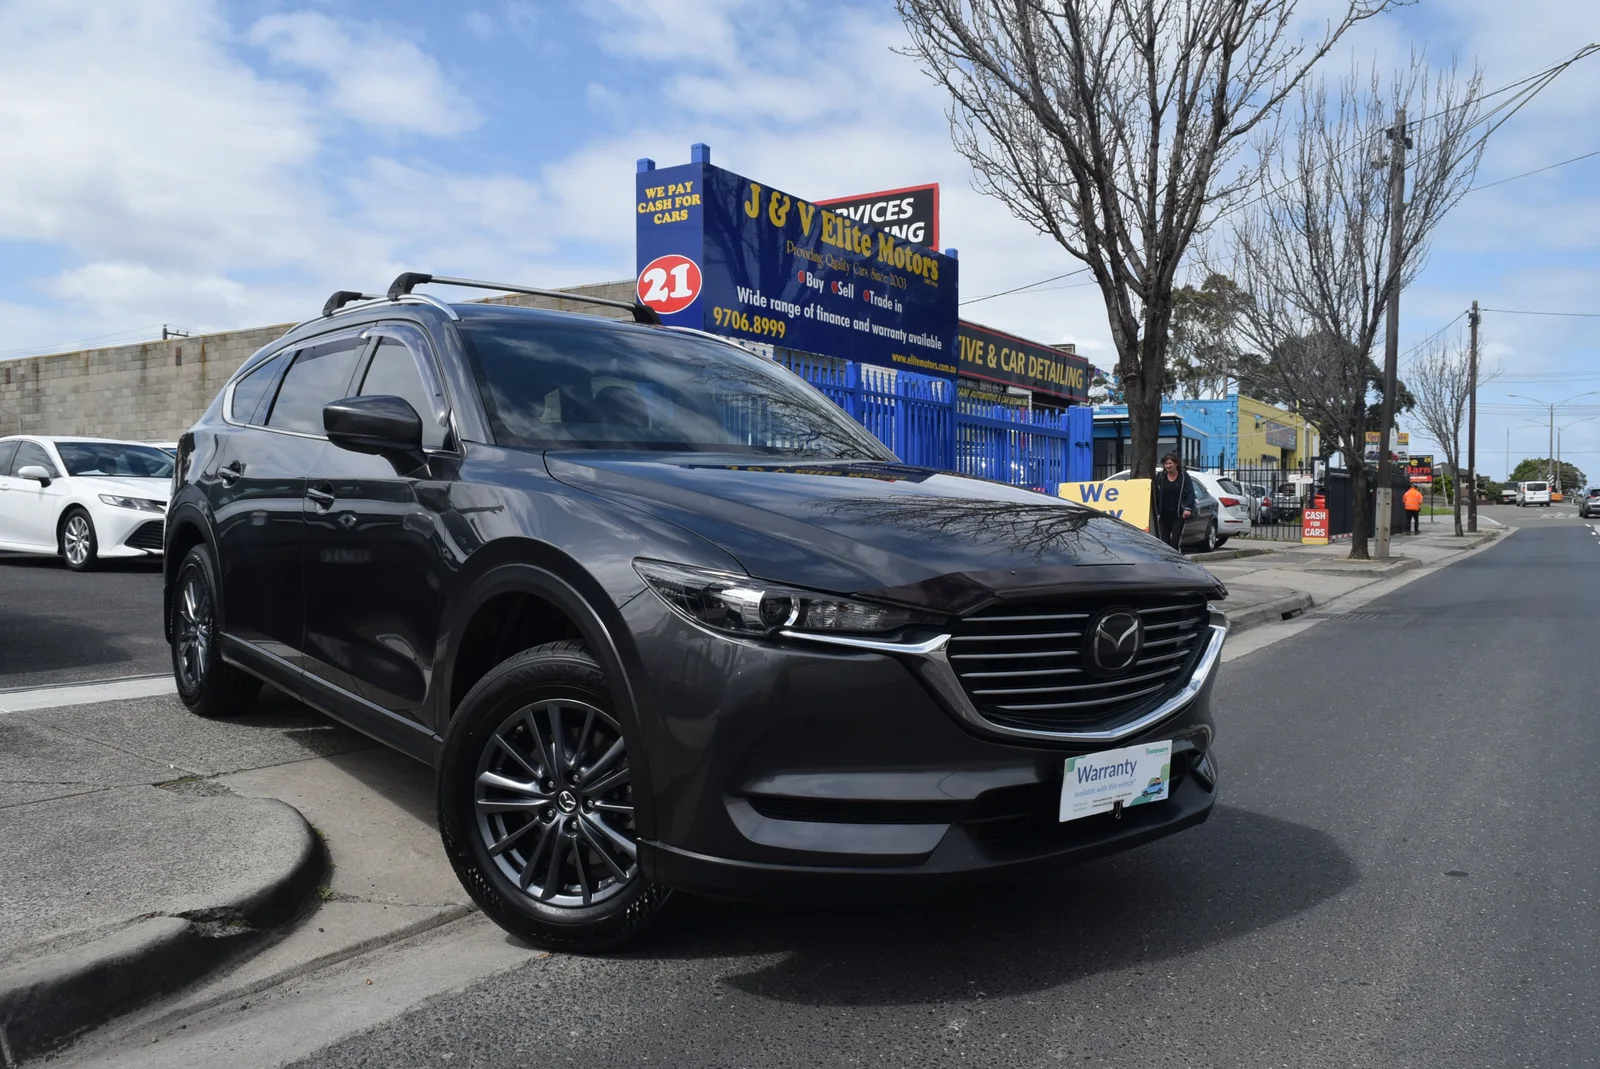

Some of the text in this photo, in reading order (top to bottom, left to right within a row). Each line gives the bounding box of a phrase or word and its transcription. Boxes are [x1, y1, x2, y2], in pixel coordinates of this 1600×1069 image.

[645, 181, 693, 199] WE PAY
[637, 193, 702, 214] CASH FOR
[653, 209, 689, 225] CARS
[744, 183, 939, 281] J & V Elite Motors
[884, 222, 925, 243] NG
[787, 240, 824, 269] Providing
[826, 254, 851, 276] Quality
[853, 262, 868, 278] Cars
[870, 267, 888, 283] Since
[643, 263, 693, 303] 21
[806, 271, 903, 314] Buy Sell Trade in
[713, 306, 786, 339] 9706.8999
[737, 285, 942, 350] Wide range of finance and warranty available
[891, 352, 957, 374] www.elitemotors.com.au
[987, 344, 997, 369] &
[1000, 348, 1025, 375] CAR
[1028, 355, 1083, 390] DETAILING
[1079, 483, 1119, 503] We
[1305, 511, 1326, 520] CASH
[1304, 528, 1326, 536] CARS
[1077, 759, 1137, 784] Warranty
[1074, 788, 1096, 798] available
[1096, 785, 1107, 793] with
[1108, 782, 1117, 790] this
